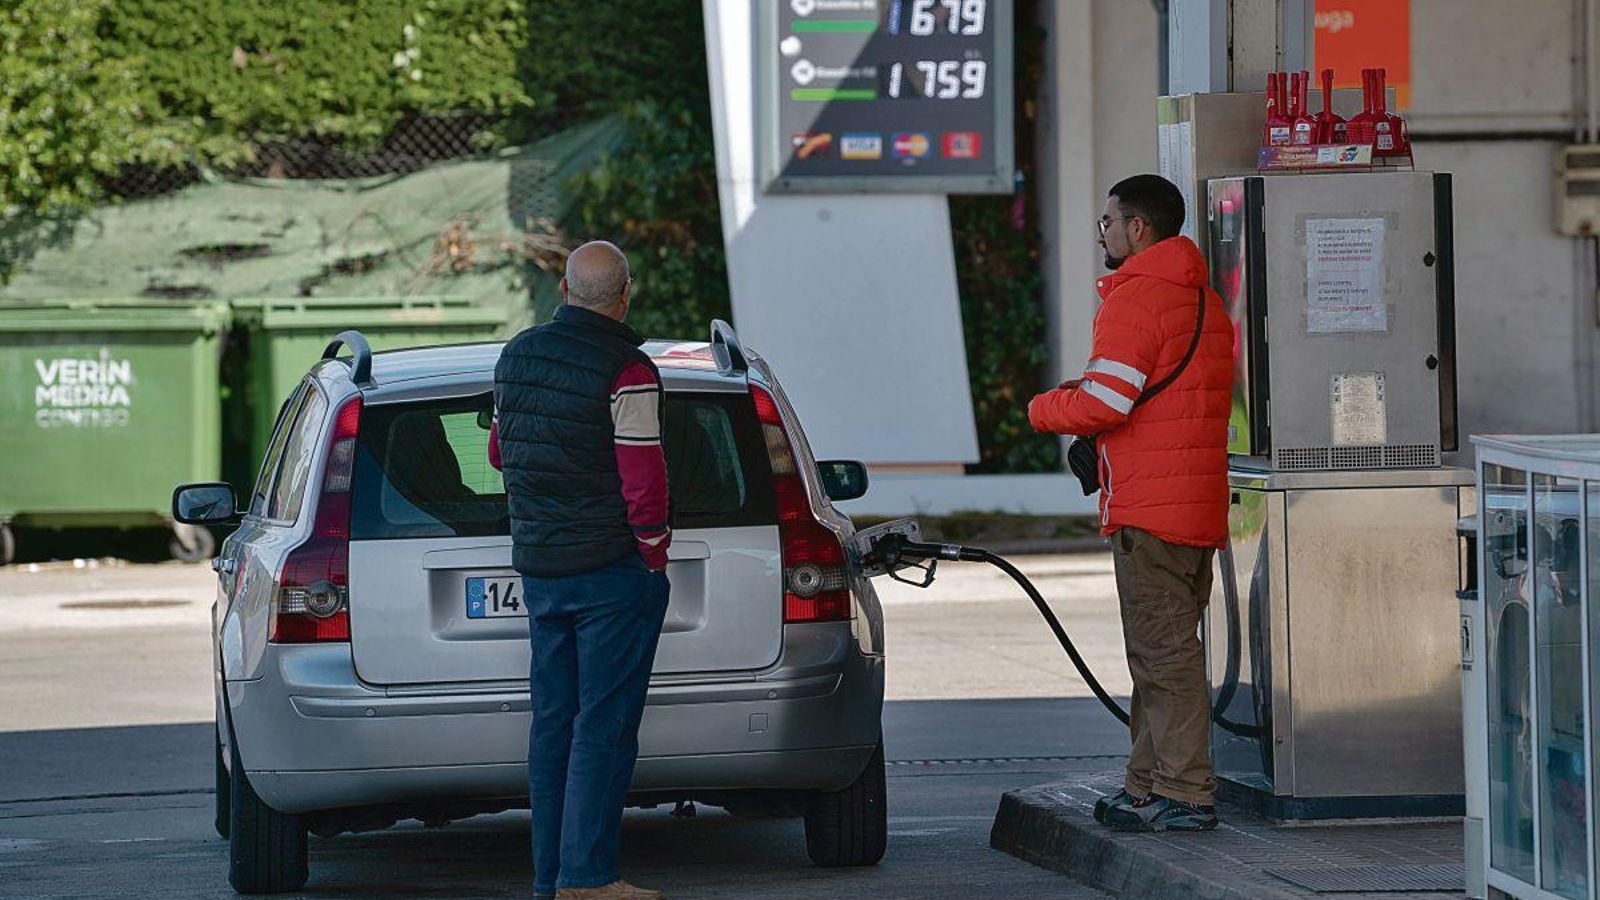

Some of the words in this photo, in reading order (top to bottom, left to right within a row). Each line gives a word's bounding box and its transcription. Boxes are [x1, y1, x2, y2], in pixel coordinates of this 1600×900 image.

[910, 0, 986, 35] 679
[916, 60, 987, 99] 759
[35, 384, 130, 407] MEDRA
[472, 602, 480, 610] P
[488, 582, 519, 612] 14
